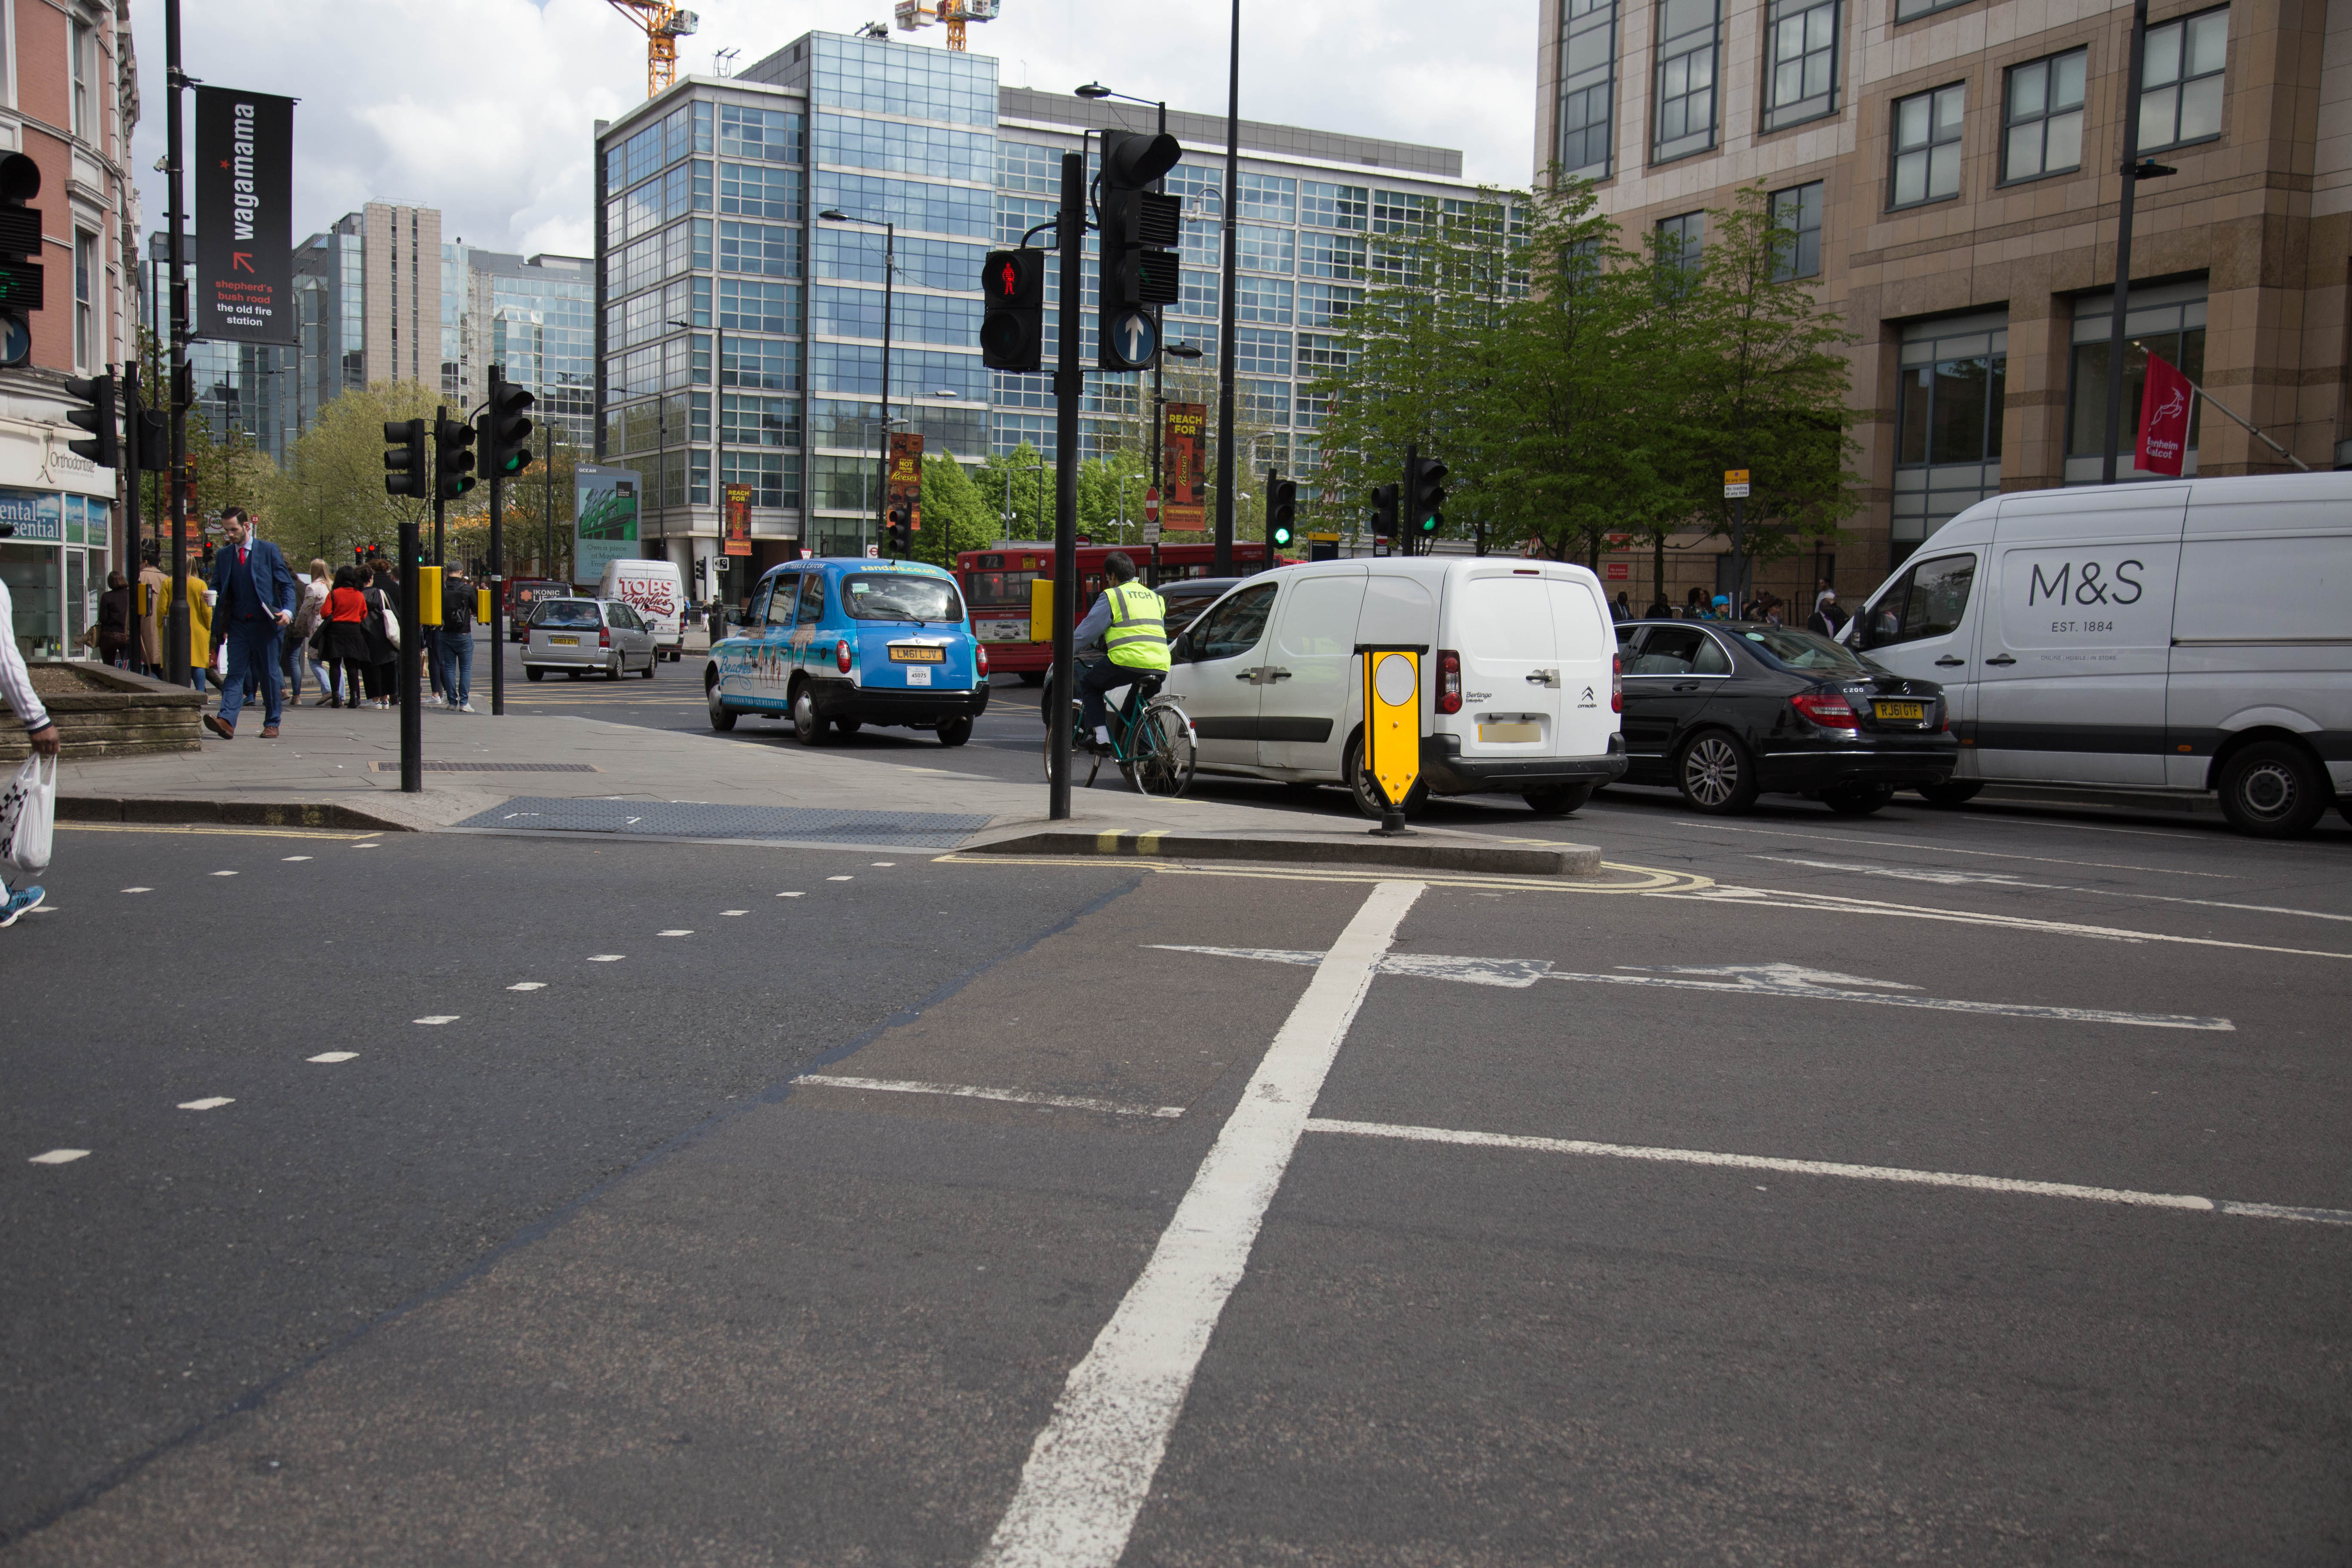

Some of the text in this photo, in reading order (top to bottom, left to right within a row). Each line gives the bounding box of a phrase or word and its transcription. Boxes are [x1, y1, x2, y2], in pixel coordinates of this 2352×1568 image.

[234, 104, 259, 240] wagamama
[215, 279, 273, 293] shepherd's
[218, 291, 270, 304] bush road
[217, 303, 272, 316] the old fire
[227, 316, 263, 326] station
[1169, 414, 1202, 425] REACH
[1174, 425, 1196, 435] FOR
[891, 471, 918, 482] Reese's
[985, 556, 998, 567] 72
[860, 565, 938, 575] sandals.co.uk
[619, 577, 674, 597] TOPS
[2029, 560, 2144, 606] M&S
[622, 592, 671, 610] Supplies
[2052, 621, 2113, 632] EST. 1884
[897, 649, 937, 658] LM61 LJV
[719, 655, 752, 674] Beaches
[762, 699, 783, 707] RESORTS
[1881, 704, 1918, 717] RJ61 GTF
